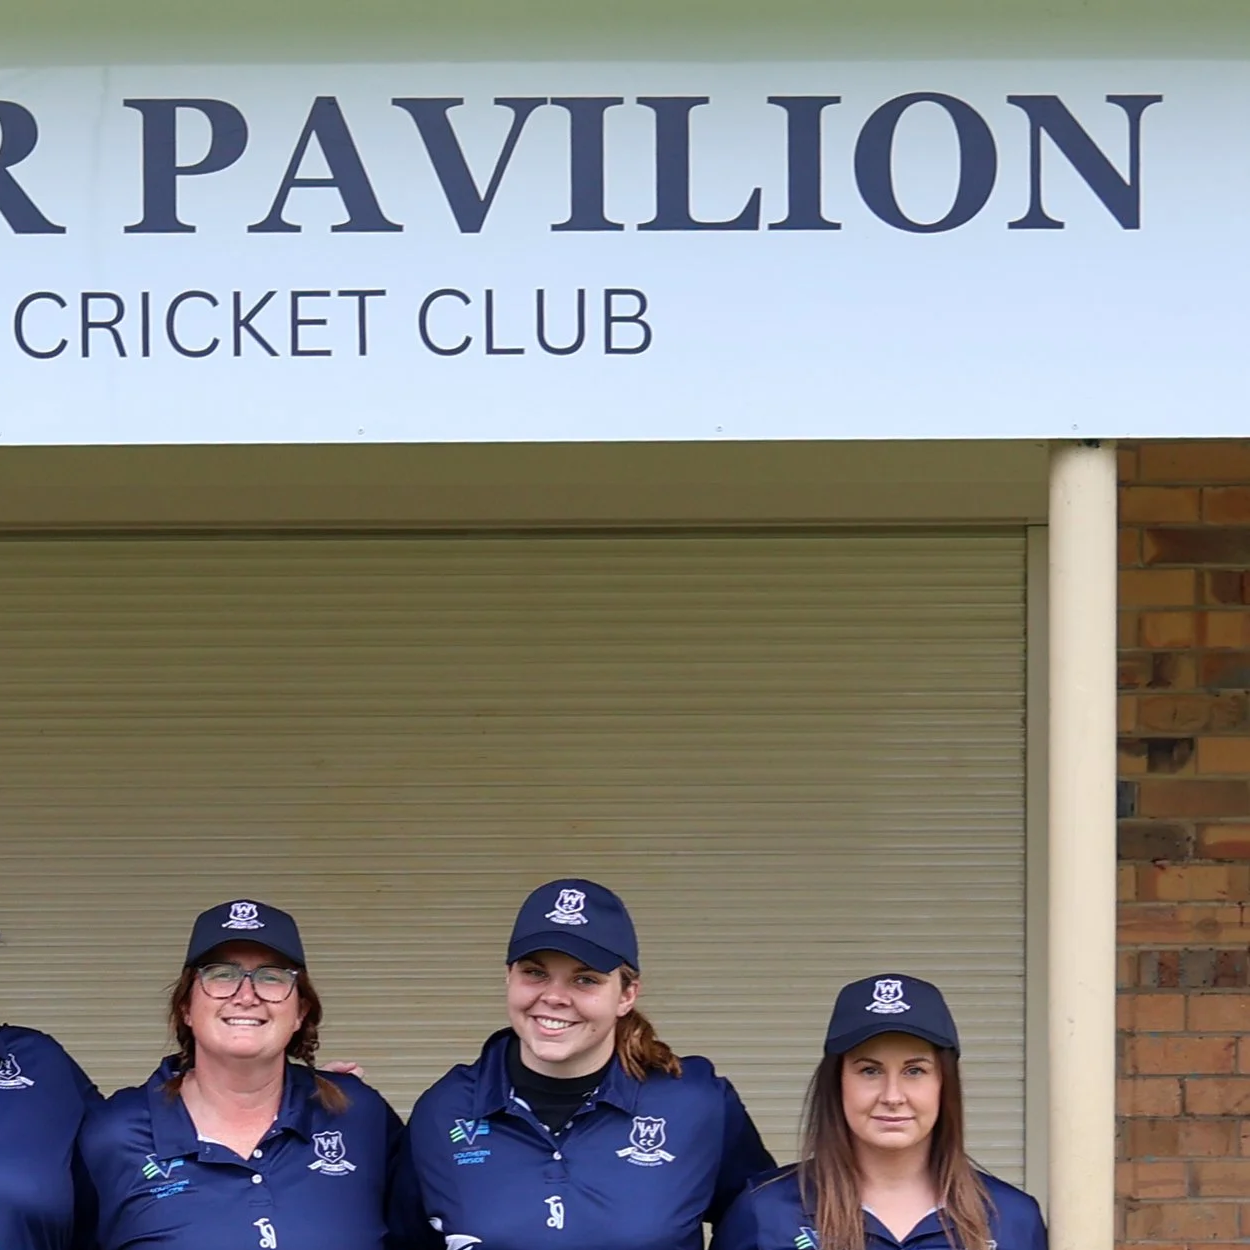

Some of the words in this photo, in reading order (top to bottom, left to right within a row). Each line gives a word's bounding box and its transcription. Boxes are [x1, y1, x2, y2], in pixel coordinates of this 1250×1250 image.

[123, 90, 1163, 235] PAVILION
[12, 288, 388, 361] CRICKET
[416, 286, 654, 357] CLUB
